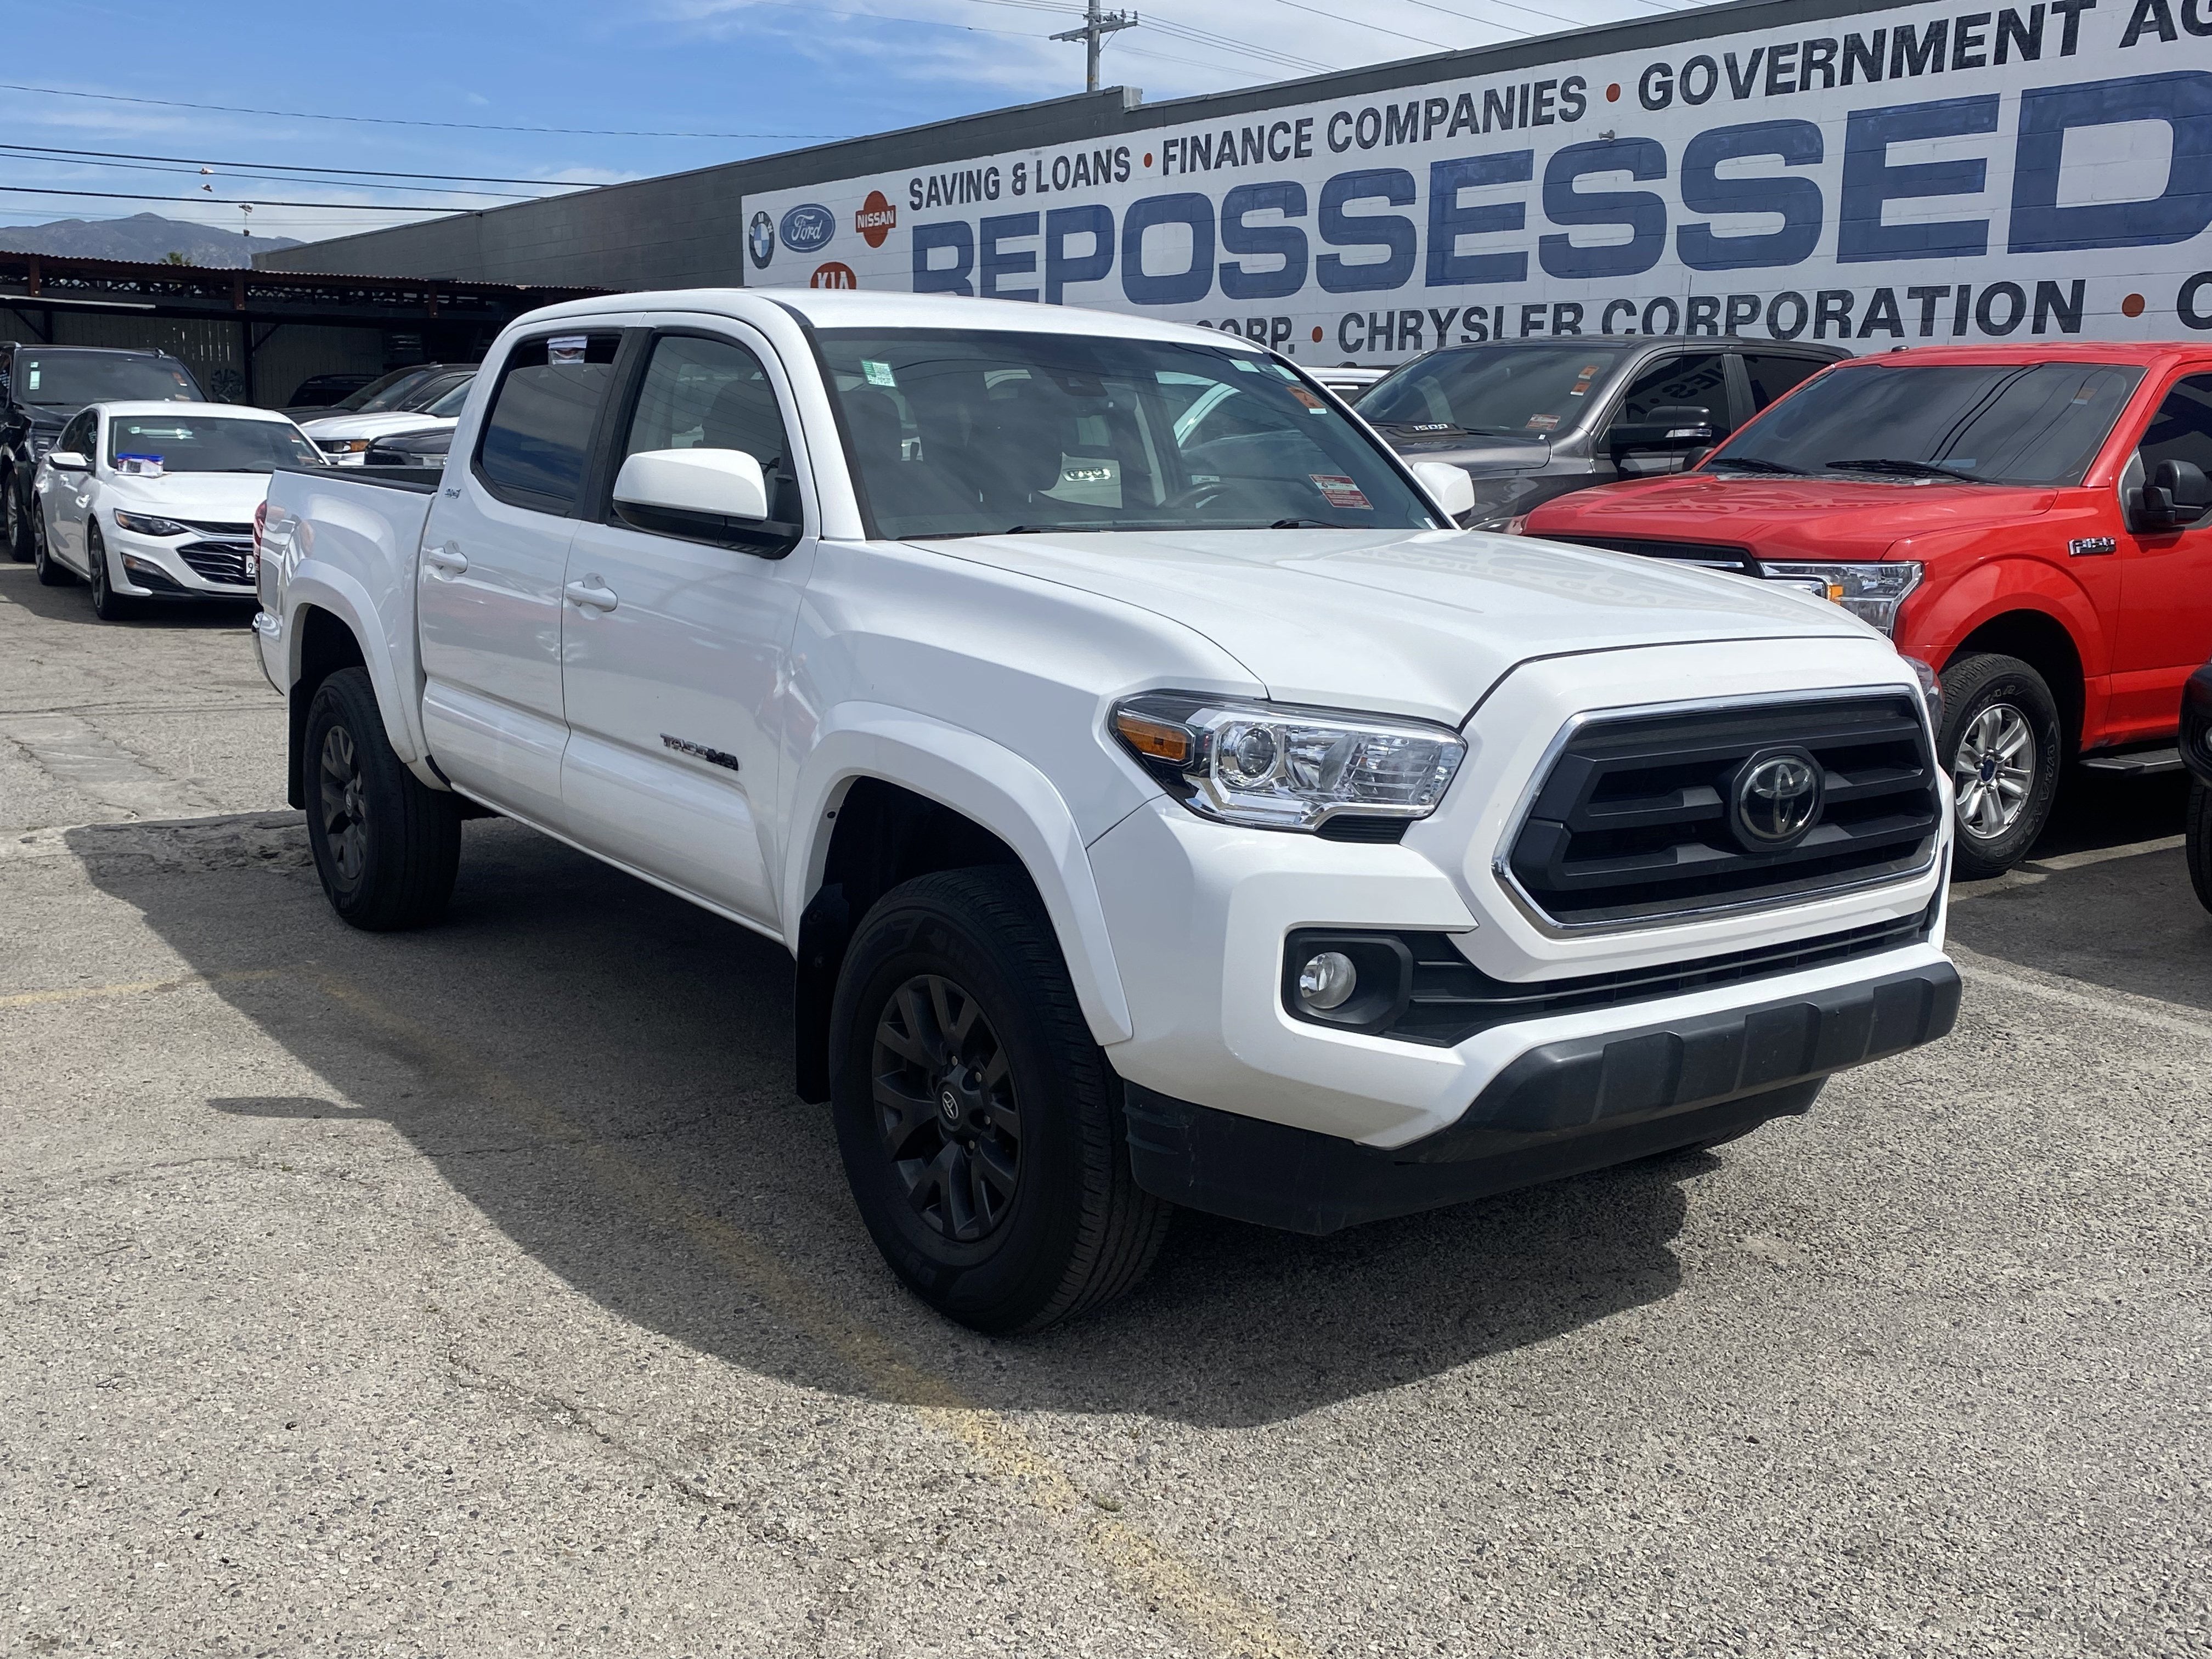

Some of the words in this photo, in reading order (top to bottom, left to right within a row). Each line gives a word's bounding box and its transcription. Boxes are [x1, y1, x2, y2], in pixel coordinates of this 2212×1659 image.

[909, 167, 1000, 211] SAVING
[1012, 162, 1026, 195] &
[1036, 146, 1131, 193] LOANS
[1163, 117, 1314, 176] FINANCE
[1328, 75, 1587, 153] COMPANIES
[1638, 1, 2097, 111] GOVERNMENT
[912, 69, 2212, 306] REPOSSESSED
[792, 215, 822, 240] Ford
[857, 210, 894, 228] NISSAN
[817, 271, 849, 289] KIA
[1196, 317, 1295, 354] RP.
[1601, 279, 2086, 340] CORPORATION
